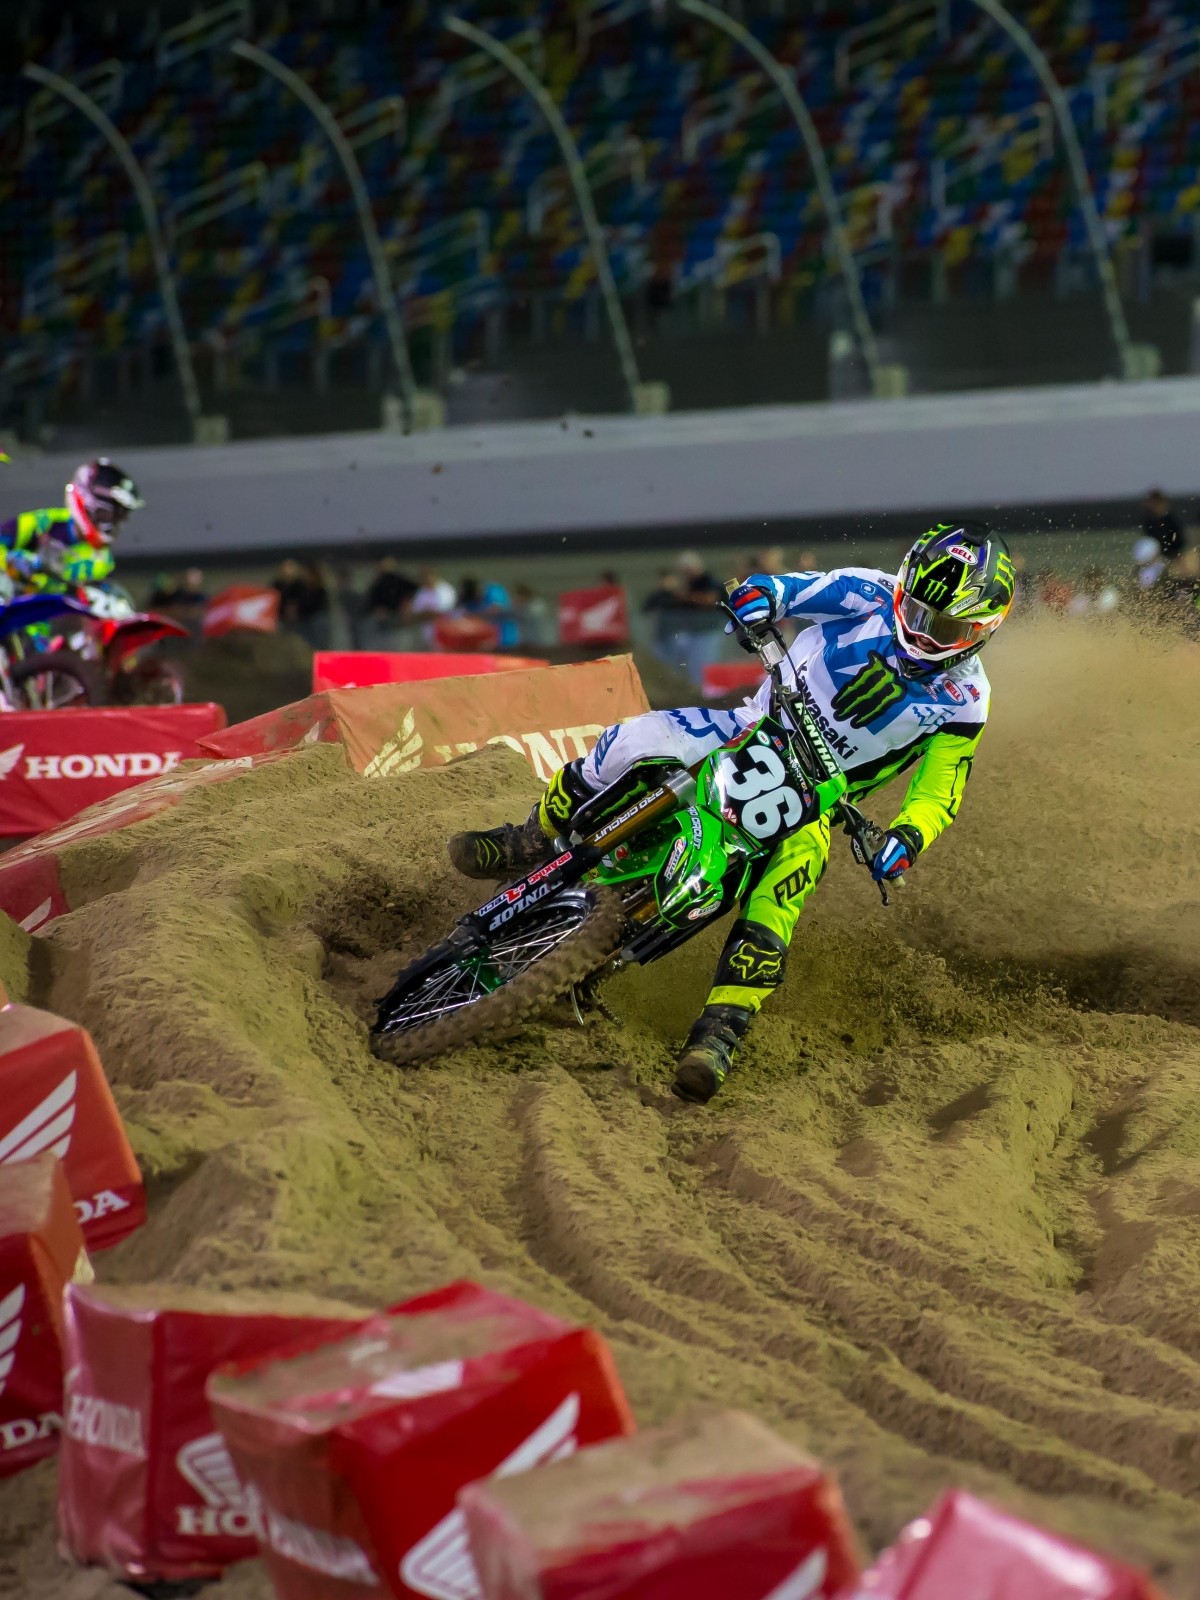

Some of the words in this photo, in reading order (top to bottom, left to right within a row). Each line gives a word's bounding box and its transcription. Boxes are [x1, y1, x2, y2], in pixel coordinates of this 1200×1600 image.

[951, 547, 974, 563] BELL
[638, 787, 665, 808] PRO
[721, 744, 803, 840] 36
[594, 805, 640, 842] CIRCUIT
[527, 851, 573, 886] BRAKING
[773, 859, 812, 907] FOX
